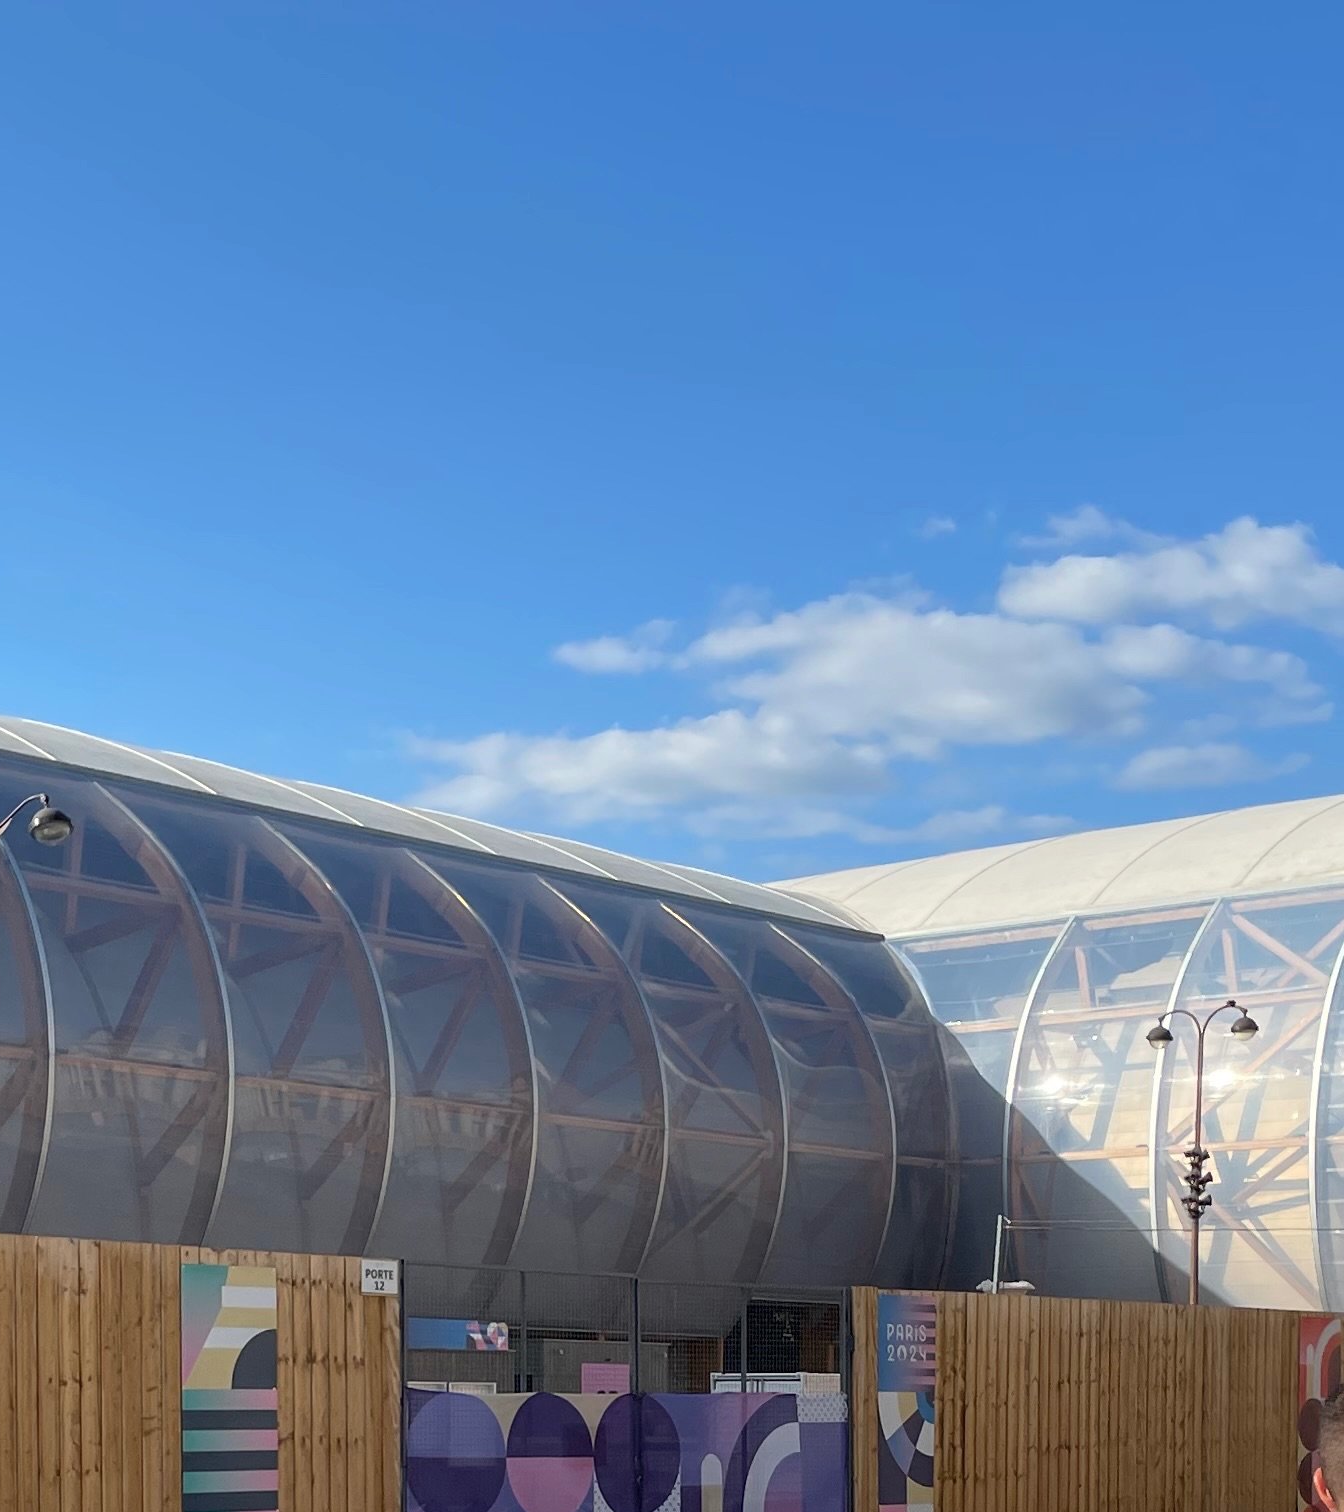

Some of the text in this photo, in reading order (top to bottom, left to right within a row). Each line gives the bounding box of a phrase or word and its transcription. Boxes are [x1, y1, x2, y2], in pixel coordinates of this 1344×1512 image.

[365, 1268, 394, 1280] PORTE
[374, 1280, 385, 1291] 12
[887, 1344, 927, 1362] 2024
